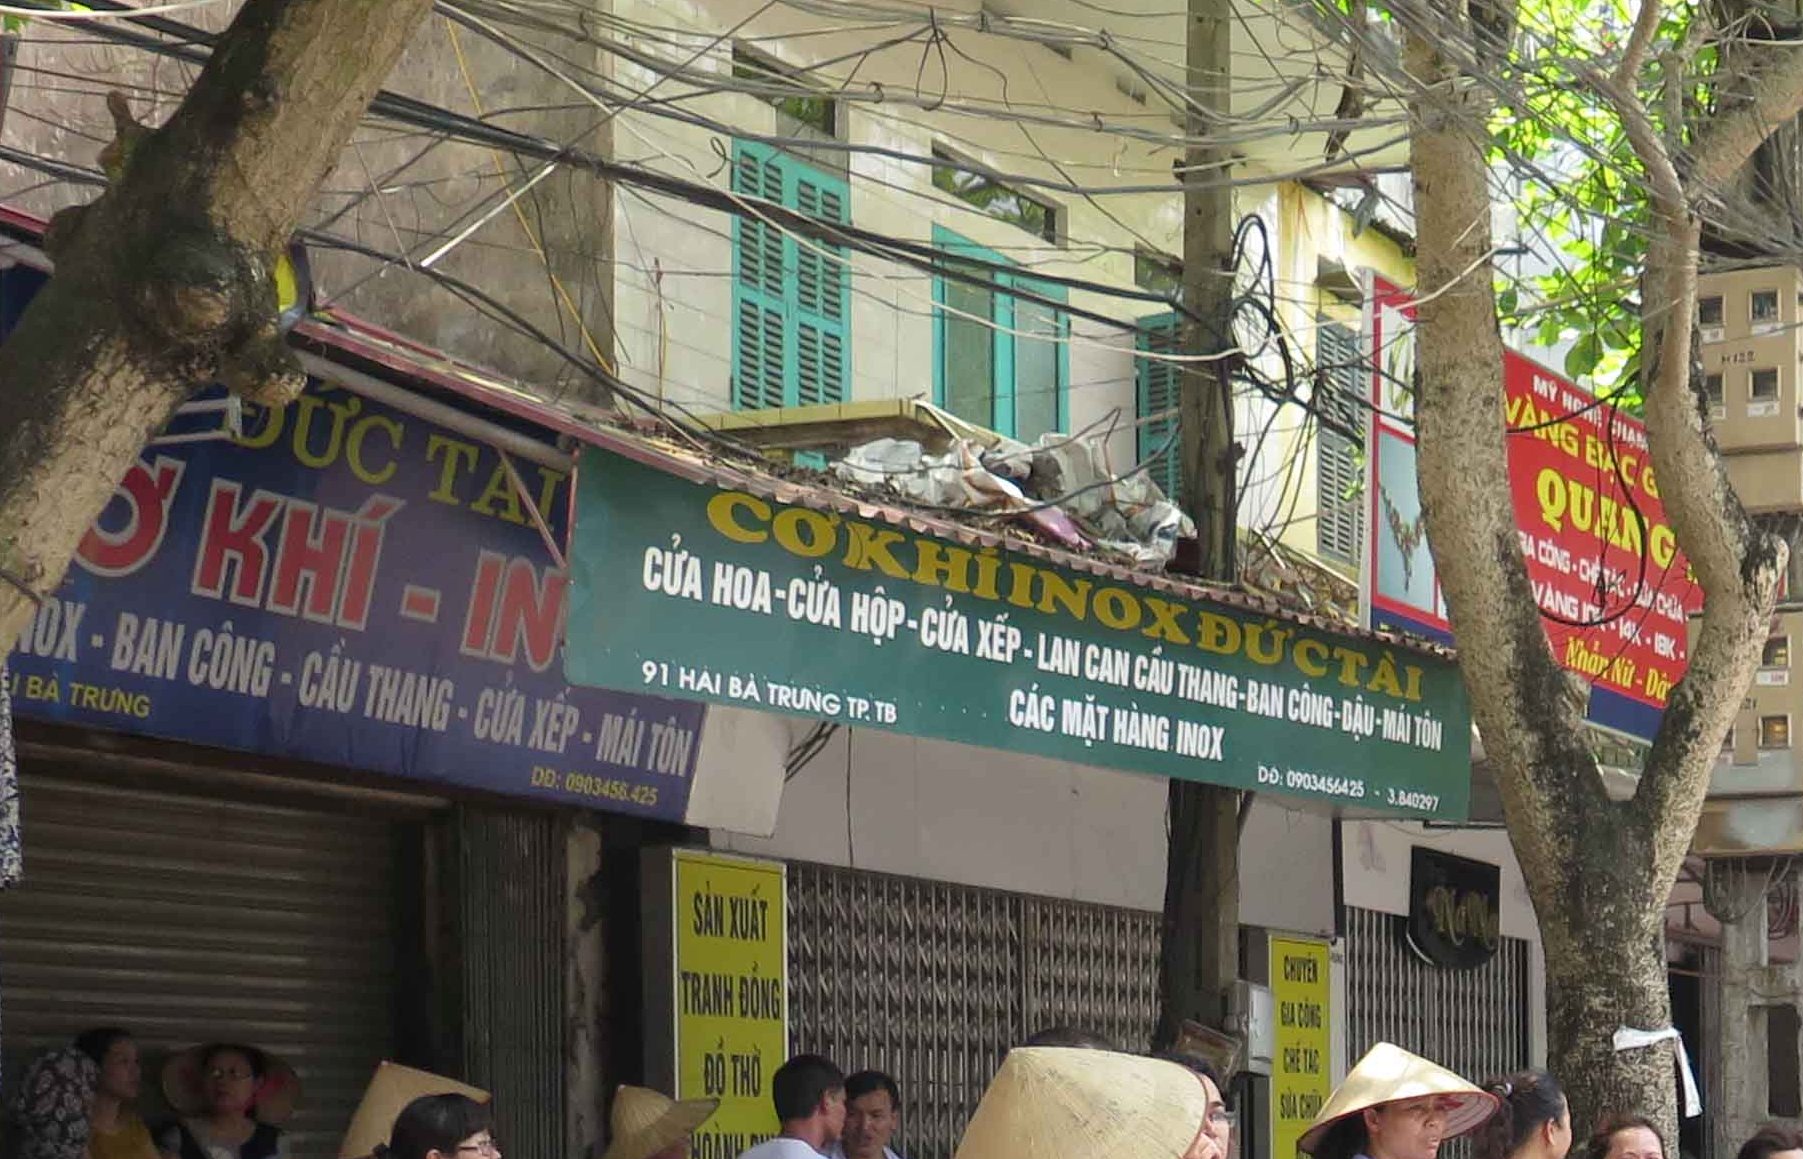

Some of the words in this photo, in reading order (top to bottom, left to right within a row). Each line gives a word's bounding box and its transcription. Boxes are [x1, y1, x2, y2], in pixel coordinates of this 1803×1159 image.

[1537, 467, 1677, 570] QUANG
[192, 477, 406, 632] KHÍ
[461, 549, 568, 673] IN
[1538, 539, 1572, 573] CÔNG
[706, 490, 841, 557] CƠ
[1006, 561, 1191, 646] INOX
[1196, 609, 1330, 678] ĐỨC
[1333, 646, 1425, 702] TÀI
[1531, 580, 1579, 620] VÀNG
[642, 533, 703, 601] CỬA
[976, 613, 1022, 664] XẾP
[1037, 631, 1080, 677] LAN
[1084, 643, 1130, 687] CAN
[1133, 645, 1175, 696] CẦU
[1414, 709, 1442, 751] TÔN
[15, 596, 86, 662] NOX
[111, 611, 186, 681] BAN
[188, 620, 275, 698] CÔNG
[300, 637, 362, 714] CẦU
[364, 664, 453, 732] THANG
[475, 669, 527, 746] CỬA
[528, 687, 580, 754] XẾP
[596, 707, 645, 768] MÁI
[648, 716, 693, 777] TÔN
[25, 672, 59, 702] BÀ
[641, 660, 669, 686] 91
[678, 665, 721, 695] HAI
[728, 672, 761, 702] BÀ
[1009, 682, 1056, 733] CÁC
[1061, 693, 1109, 747] MẶT
[1113, 701, 1170, 751] HÀNG
[1175, 720, 1225, 762] INOX
[729, 883, 769, 942] XUẤT
[681, 971, 734, 1018] TRANH
